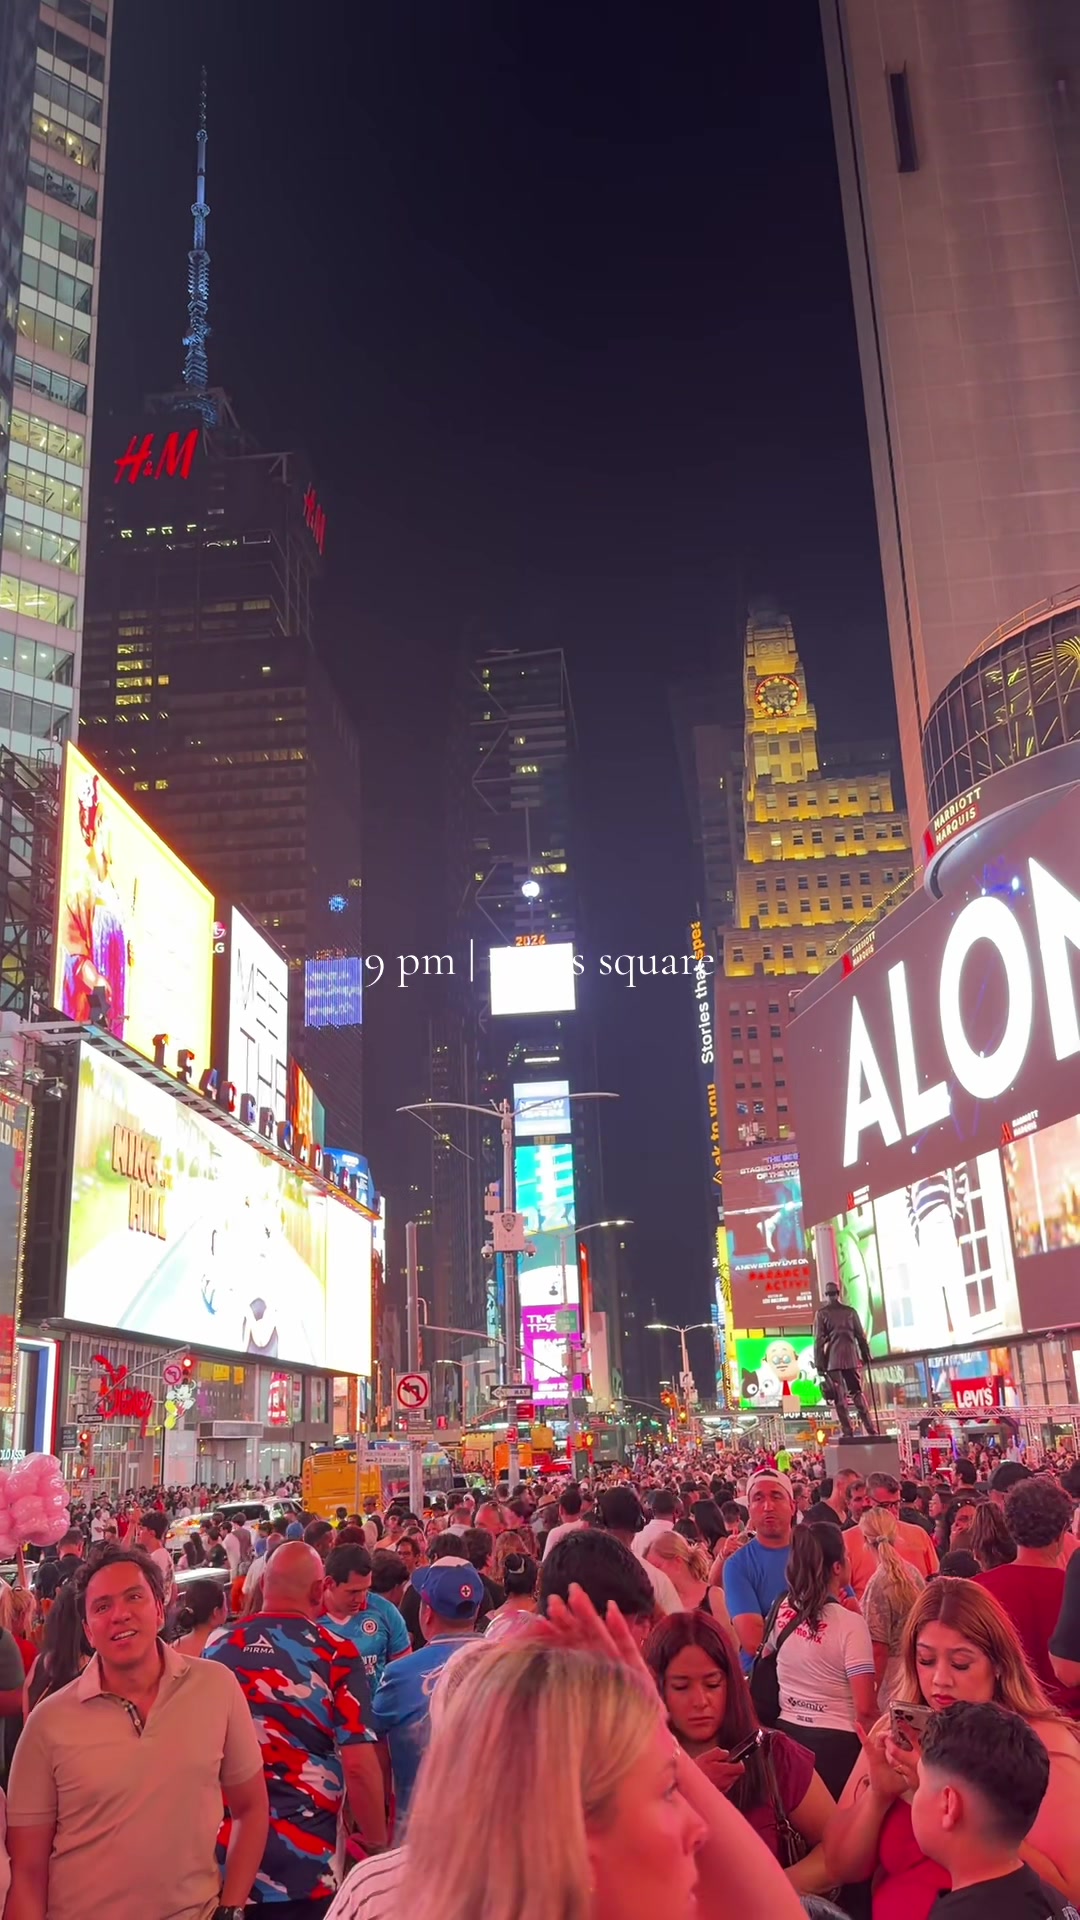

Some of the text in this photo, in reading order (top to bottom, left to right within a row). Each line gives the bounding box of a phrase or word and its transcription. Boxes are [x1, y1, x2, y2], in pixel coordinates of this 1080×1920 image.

[113, 428, 199, 484] H&M
[934, 787, 981, 831] MARRIOTT
[935, 807, 977, 846] MARQUIS
[699, 1002, 714, 1064] Stories
[242, 1646, 275, 1654] PIRMA
